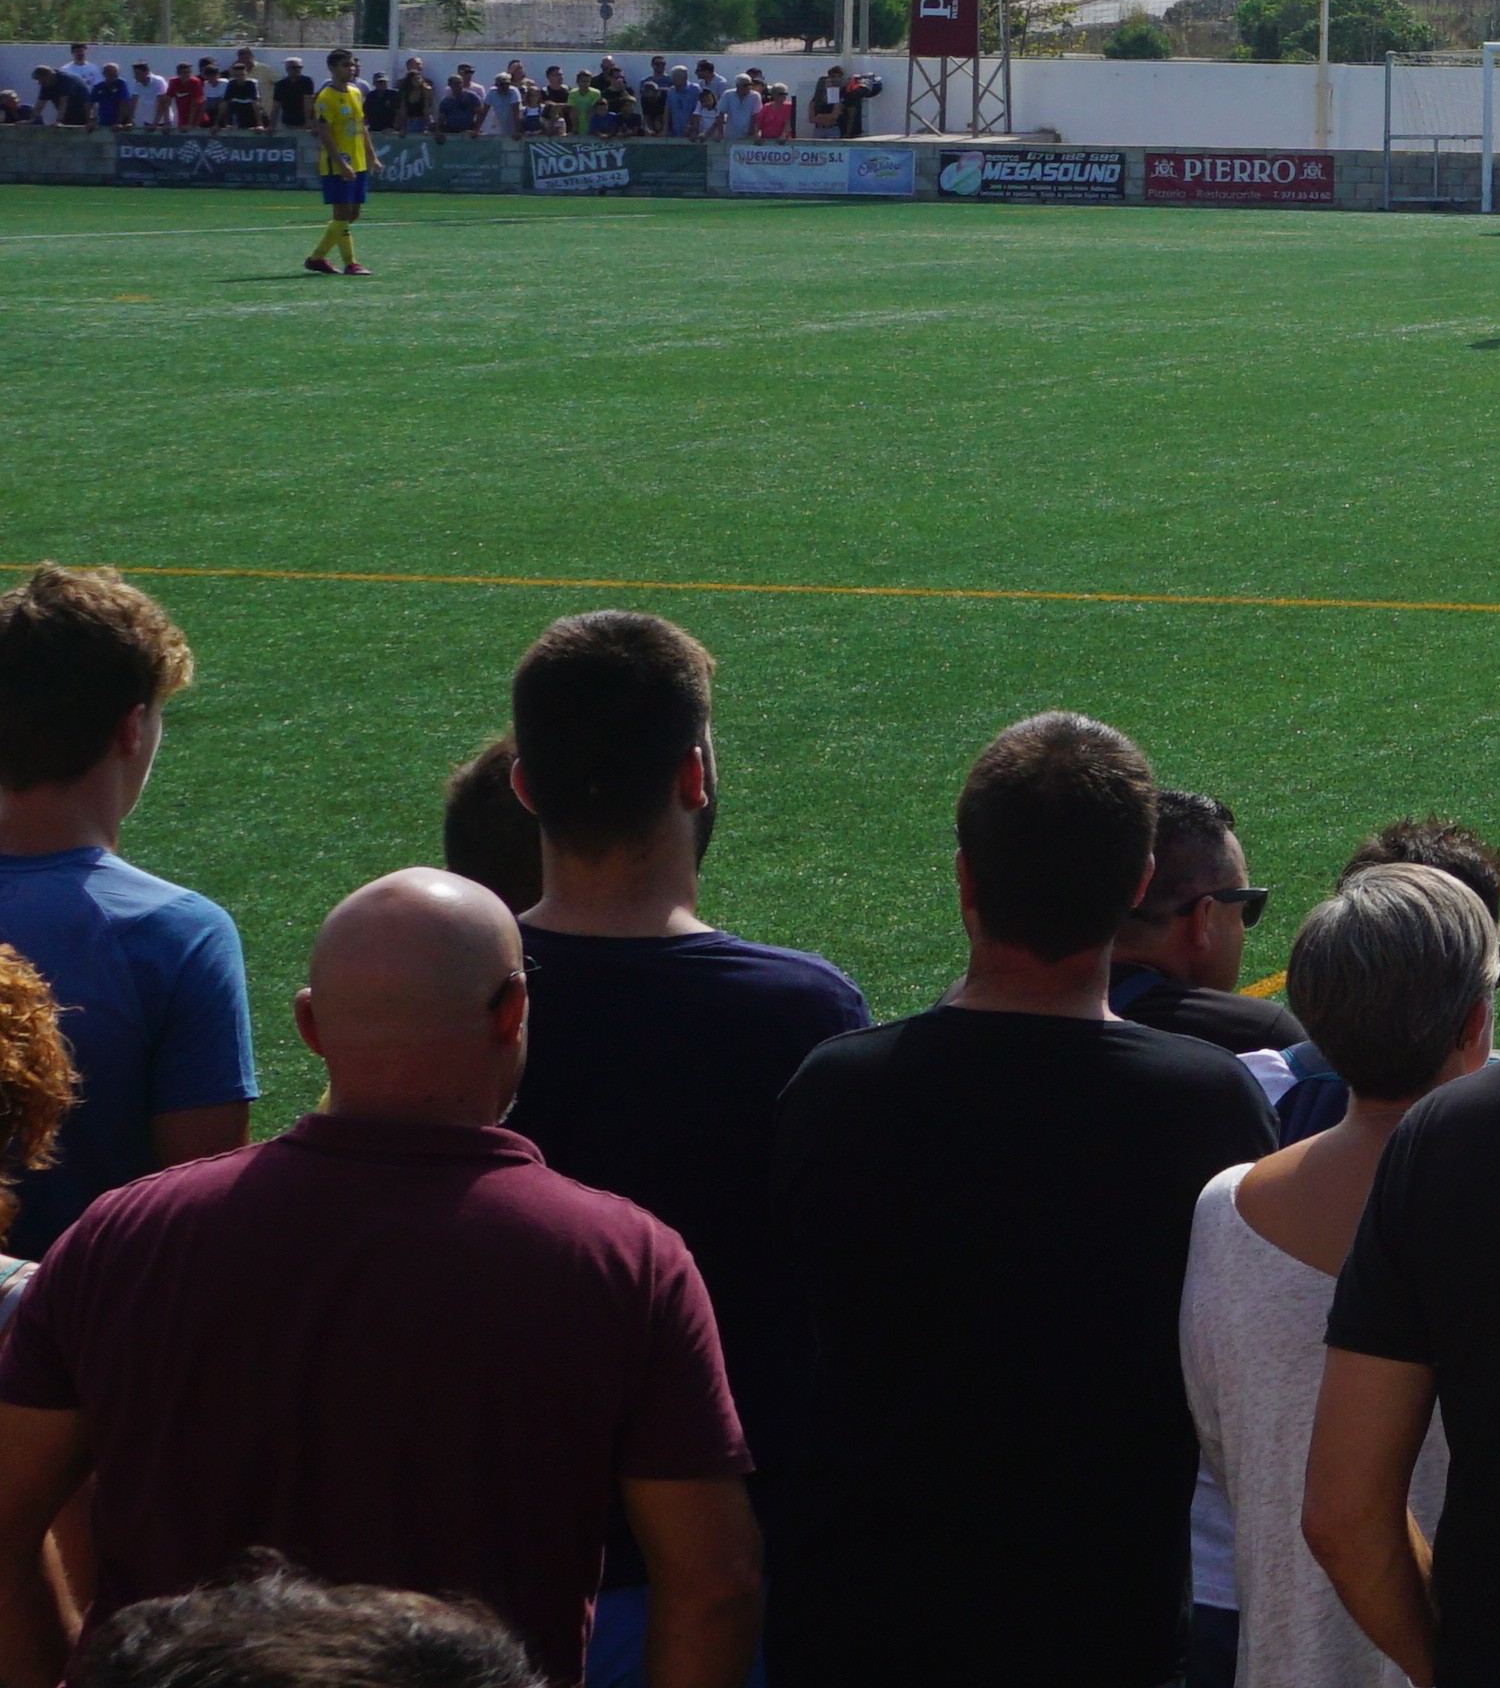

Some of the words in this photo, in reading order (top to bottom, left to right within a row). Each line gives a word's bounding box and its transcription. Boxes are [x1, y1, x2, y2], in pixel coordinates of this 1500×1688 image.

[119, 145, 174, 160] DOMI
[229, 148, 296, 162] AUTOS
[537, 147, 627, 177] MONTY
[1183, 158, 1296, 184] PIERRO
[982, 162, 1122, 183] MEGASOUND
[1196, 189, 1262, 200] Restaurante
